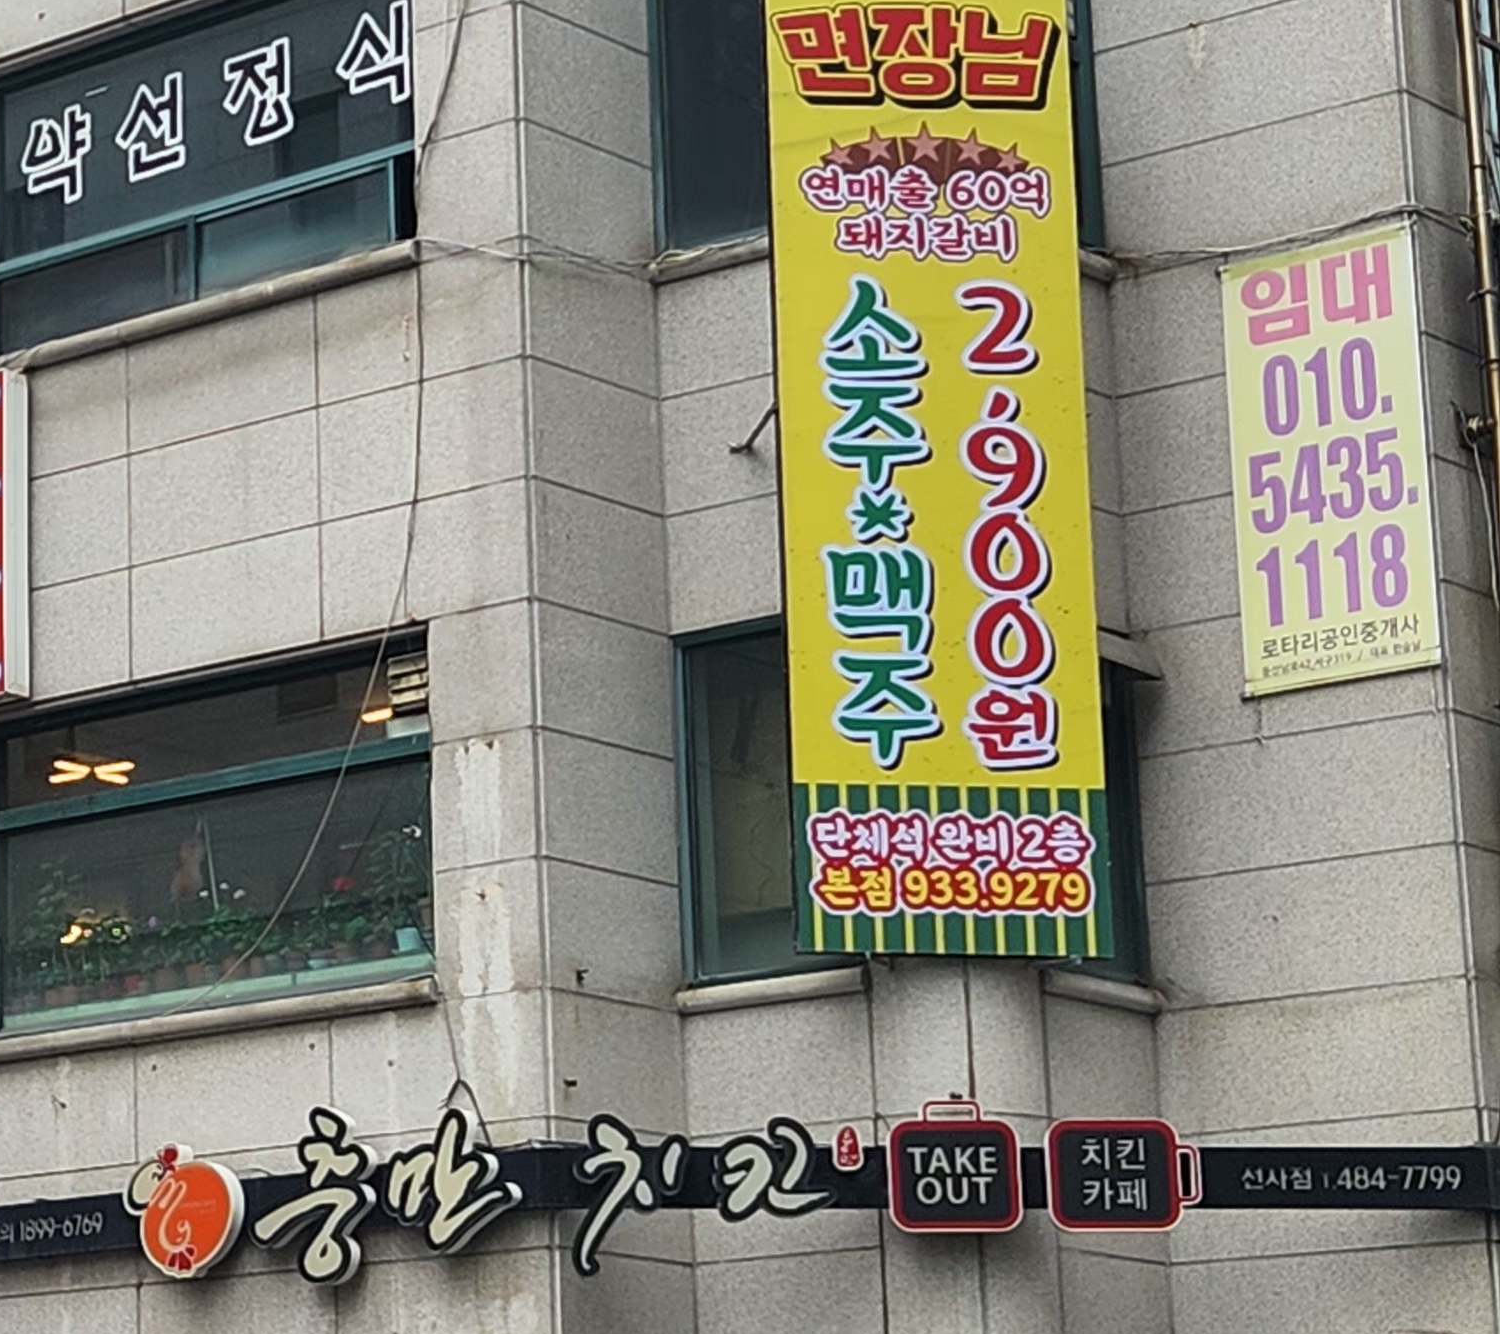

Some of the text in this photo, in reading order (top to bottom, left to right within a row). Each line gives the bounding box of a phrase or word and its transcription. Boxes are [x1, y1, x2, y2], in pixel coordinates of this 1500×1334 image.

[772, 2, 1060, 110] 면장님
[19, 0, 412, 207] 약선정식
[801, 166, 1051, 216] 연매출 60억
[838, 215, 1017, 260] 돼지갈비
[1240, 243, 1393, 347] 임대
[1262, 337, 1392, 437] 010.
[1248, 427, 1419, 535] 5435.
[1256, 523, 1409, 627] 1118
[1261, 613, 1420, 661] 로타리공인중개사
[811, 812, 1094, 864] 단체석 완비 2층
[818, 869, 1087, 909] 본점 933.9279
[906, 1145, 998, 1175] TAKE
[1080, 1136, 1148, 1172] 치킨
[915, 1176, 994, 1206] OUT
[1081, 1178, 1150, 1213] 카페
[1240, 1167, 1314, 1192] 선사점
[18, 1210, 104, 1244] 1899-6769
